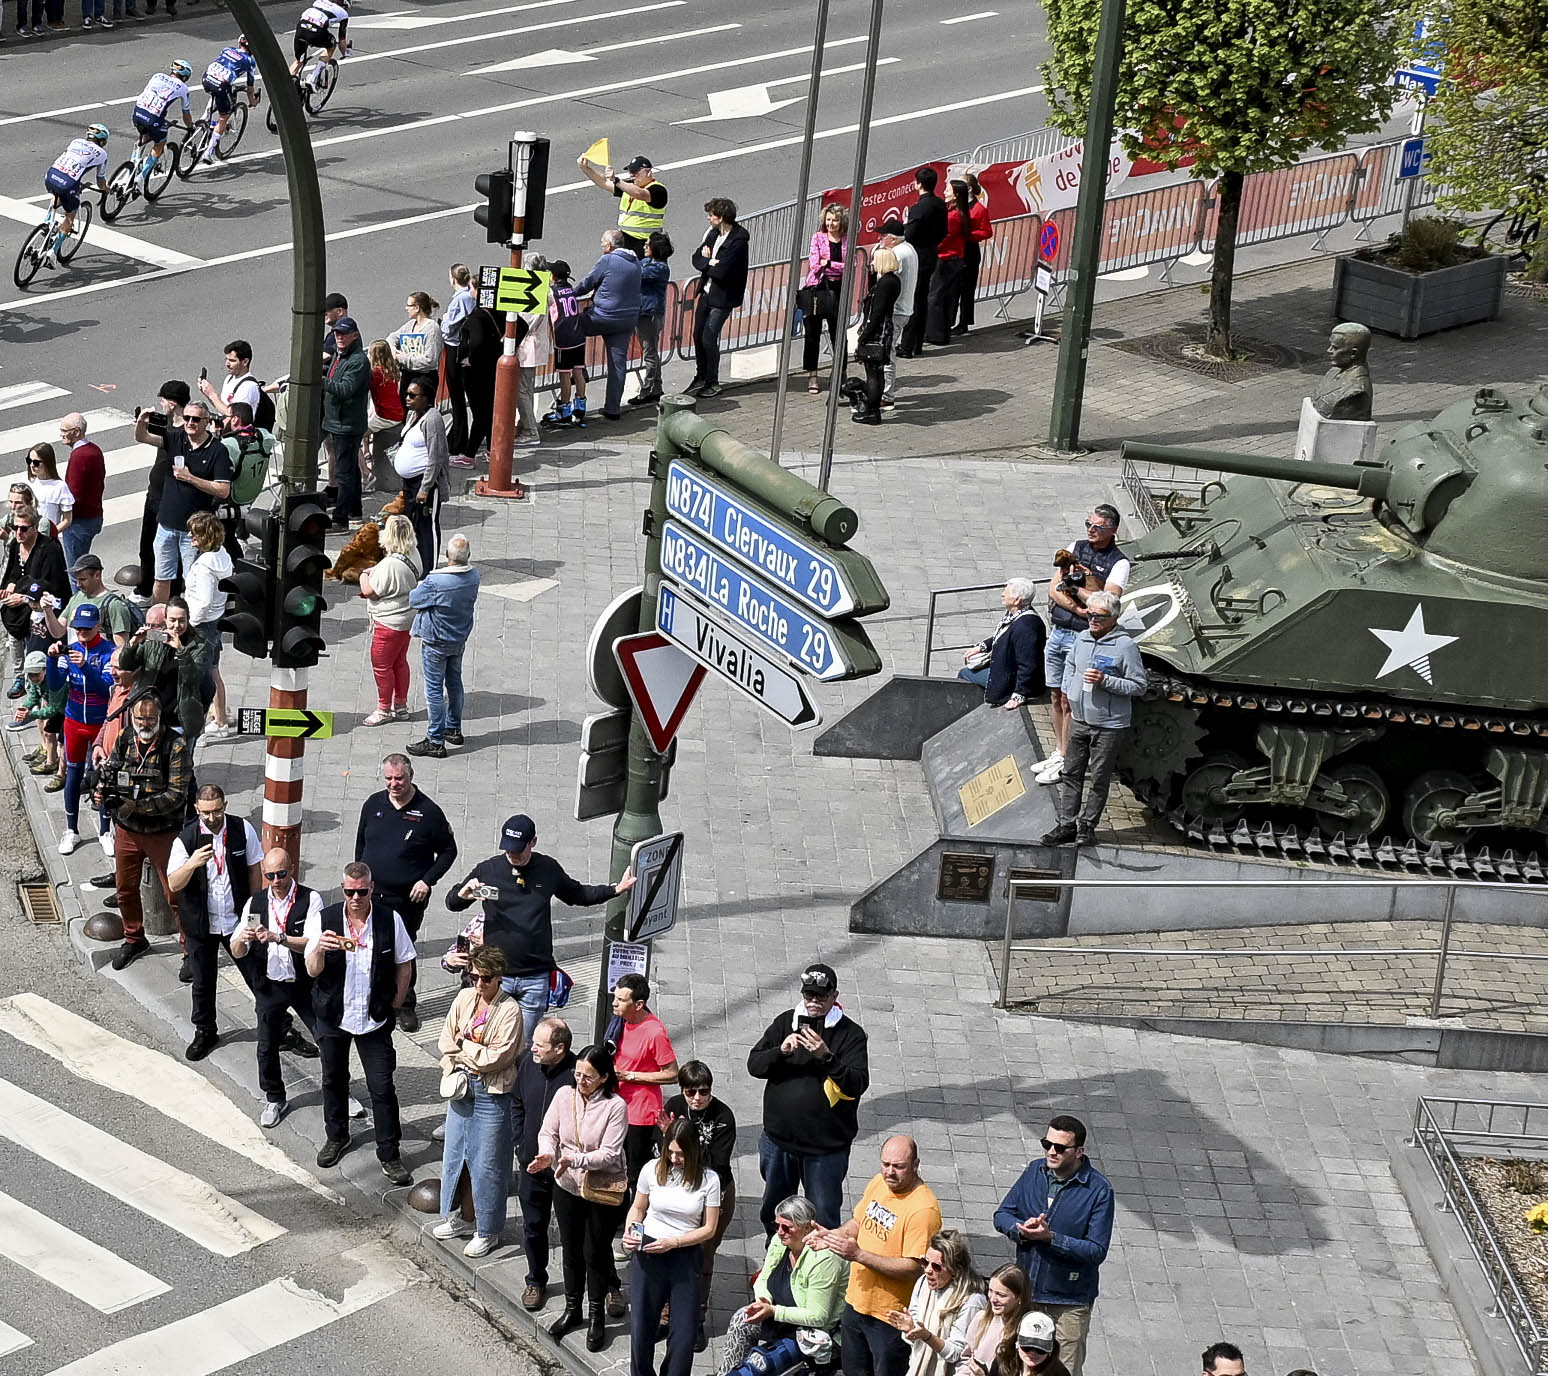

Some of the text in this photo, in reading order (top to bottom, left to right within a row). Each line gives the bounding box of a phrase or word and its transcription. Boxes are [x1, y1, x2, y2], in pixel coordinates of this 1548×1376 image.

[1404, 149, 1420, 169] WC
[1056, 171, 1076, 192] de
[559, 296, 578, 318] 10
[251, 460, 264, 478] 17
[670, 475, 834, 606] N874 Clervaux 29
[664, 535, 826, 670] N834 La Roche 29
[696, 615, 766, 697] Vivalia
[242, 709, 250, 734] LIEGE
[253, 710, 262, 734] LIEGE
